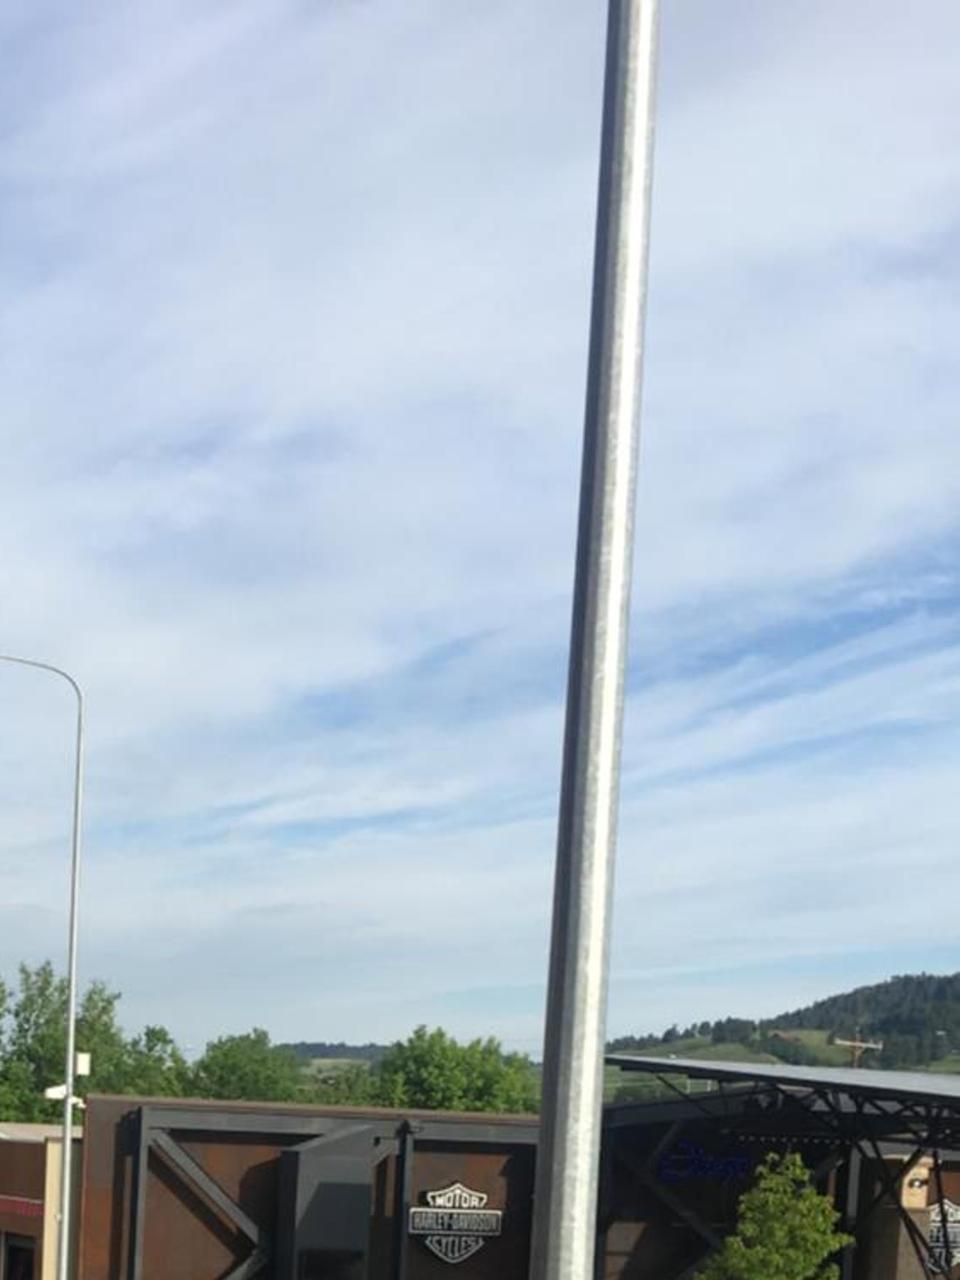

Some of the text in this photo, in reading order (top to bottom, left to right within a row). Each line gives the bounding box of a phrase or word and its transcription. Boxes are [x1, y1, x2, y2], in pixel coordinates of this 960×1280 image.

[435, 1189, 480, 1208] MOTOR
[413, 1211, 498, 1231] HARLEY-DAVIDSON
[432, 1235, 477, 1257] CYCLES
